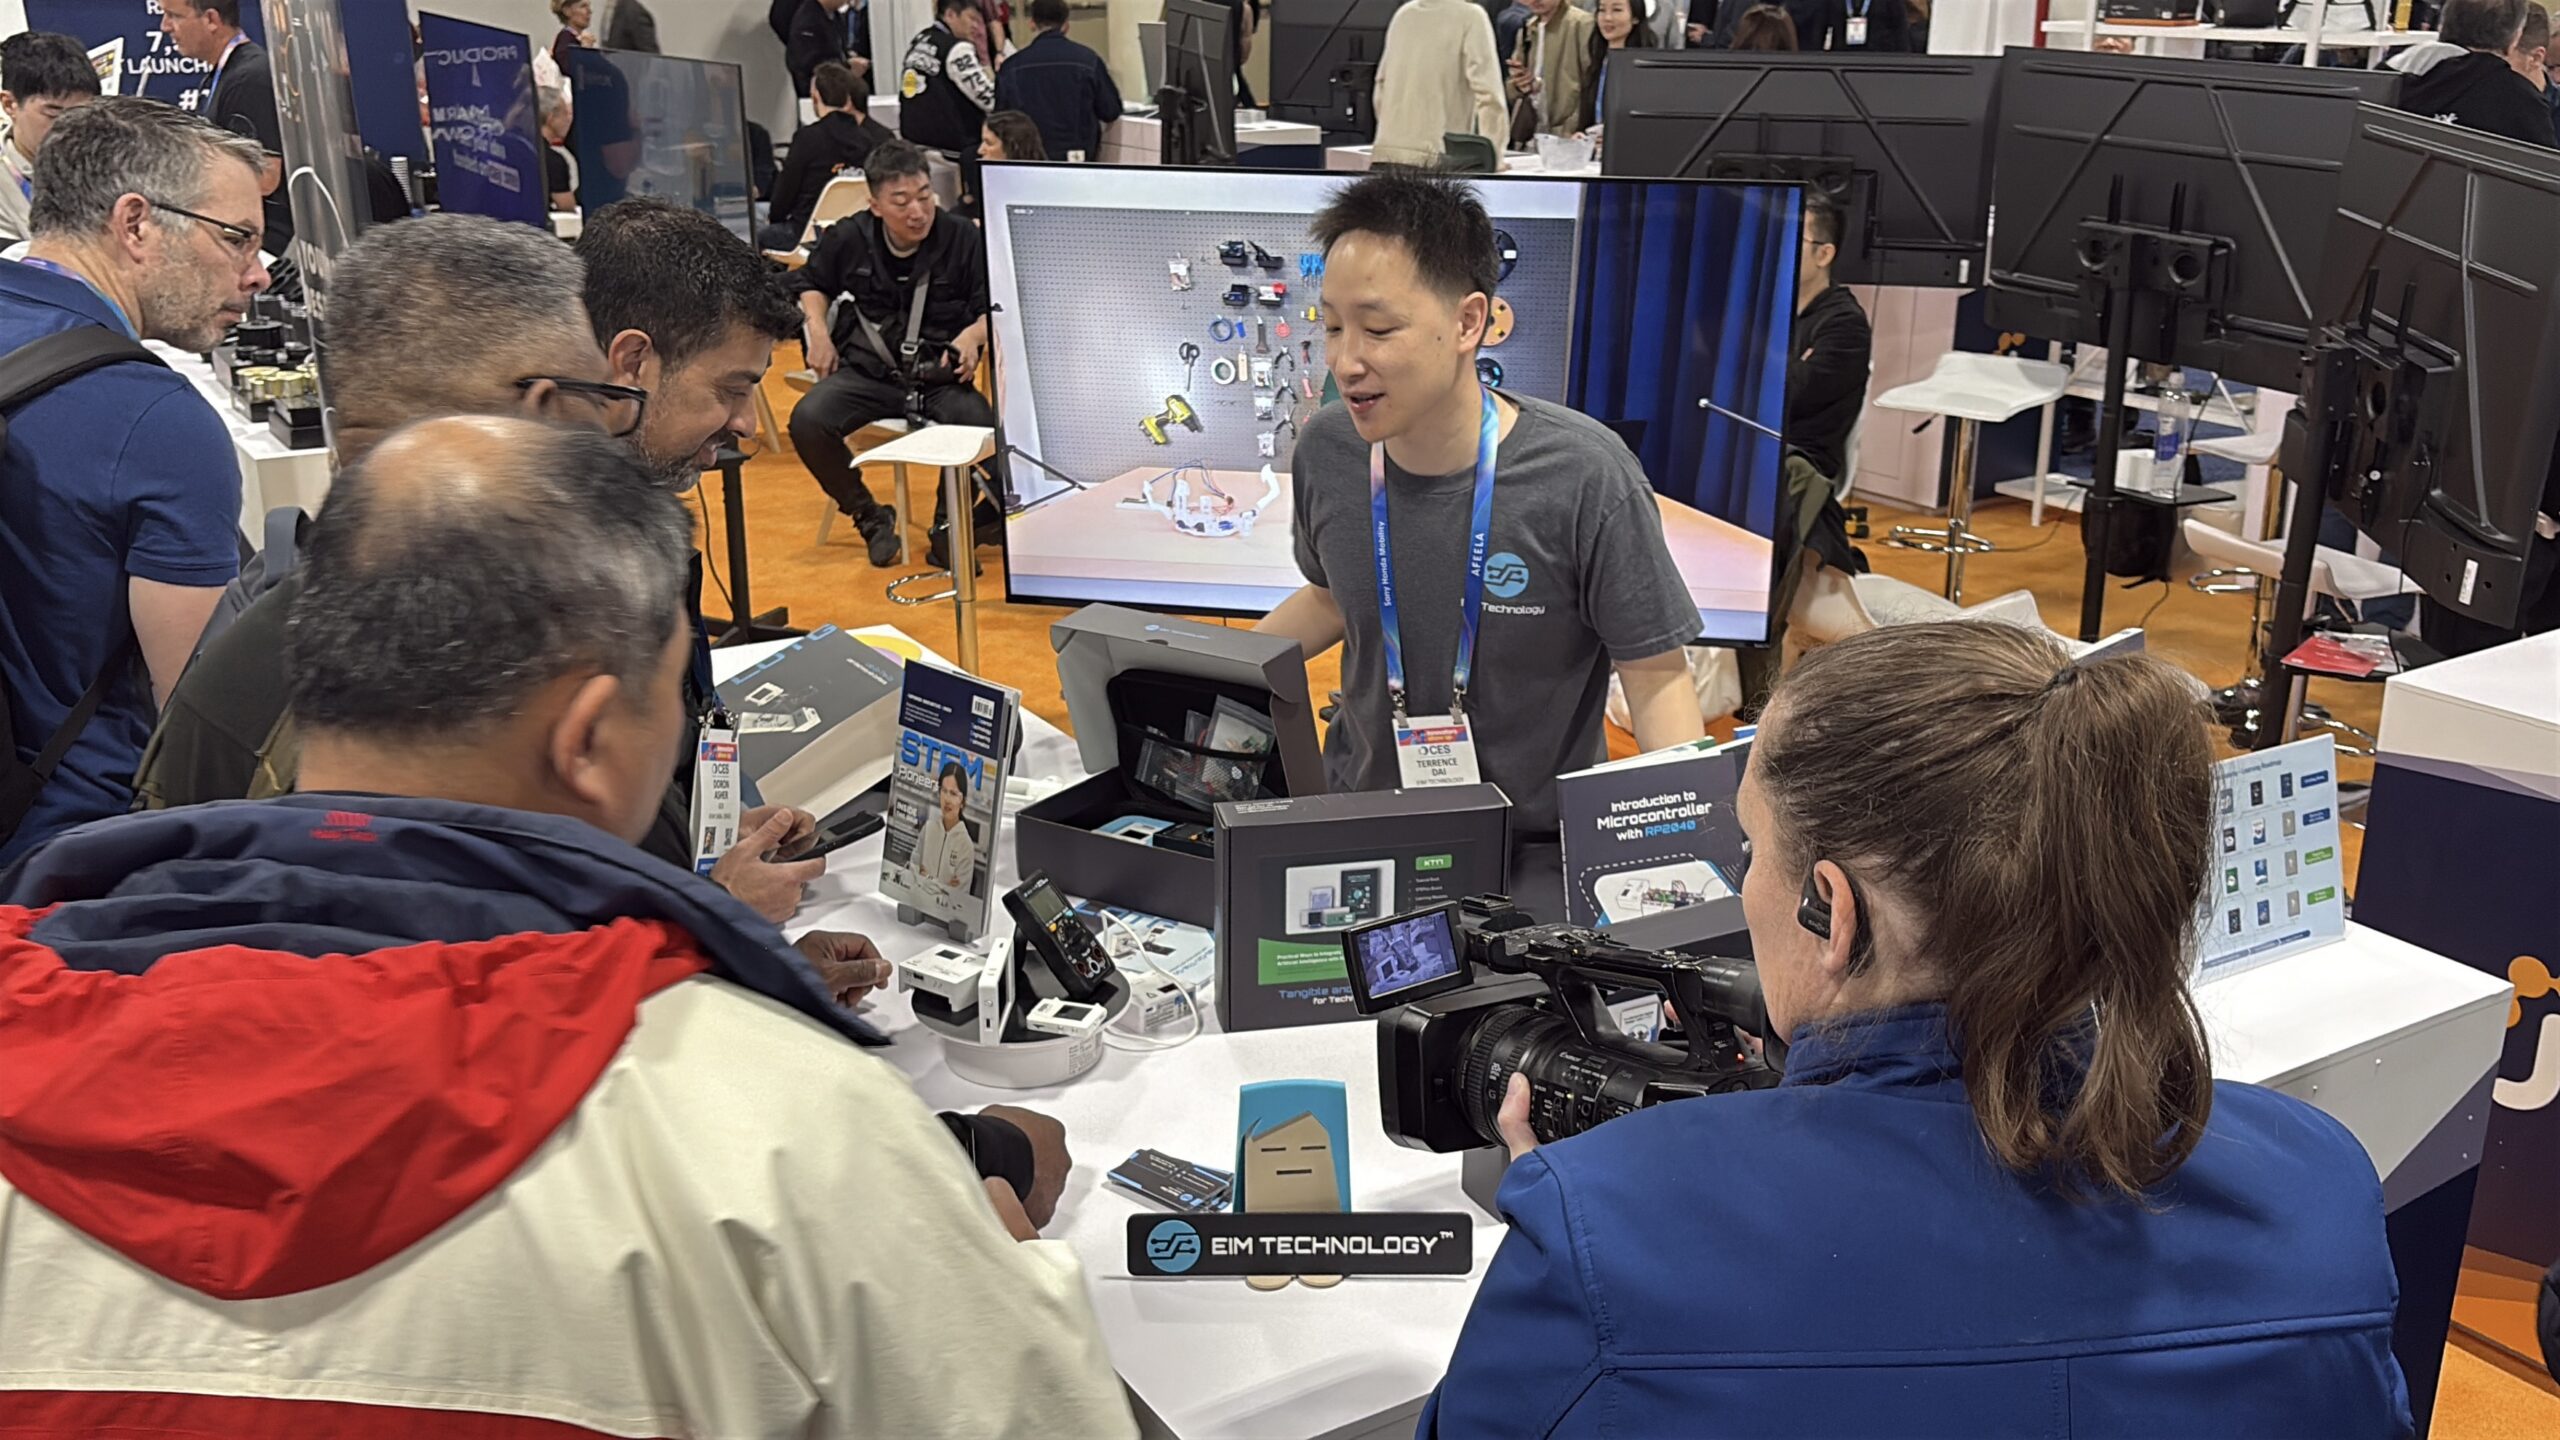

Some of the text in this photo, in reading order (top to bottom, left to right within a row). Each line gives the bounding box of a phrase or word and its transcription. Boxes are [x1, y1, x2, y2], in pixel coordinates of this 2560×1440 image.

[1377, 520, 1386, 556] Mobility
[1470, 532, 1485, 577] AFEELA
[1380, 557, 1389, 585] Honda
[1480, 601, 1546, 616] Technology
[1429, 744, 1451, 755] CES
[1416, 758, 1458, 768] TERRENCE
[1432, 768, 1447, 777] DAI
[1611, 790, 1697, 813] Introduction to
[1597, 803, 1712, 831] Microcontroller
[1616, 820, 1697, 841] with RP2040
[1279, 987, 1328, 999] Tangible
[1312, 997, 1327, 1005] for
[1211, 1236, 1253, 1255] EIM
